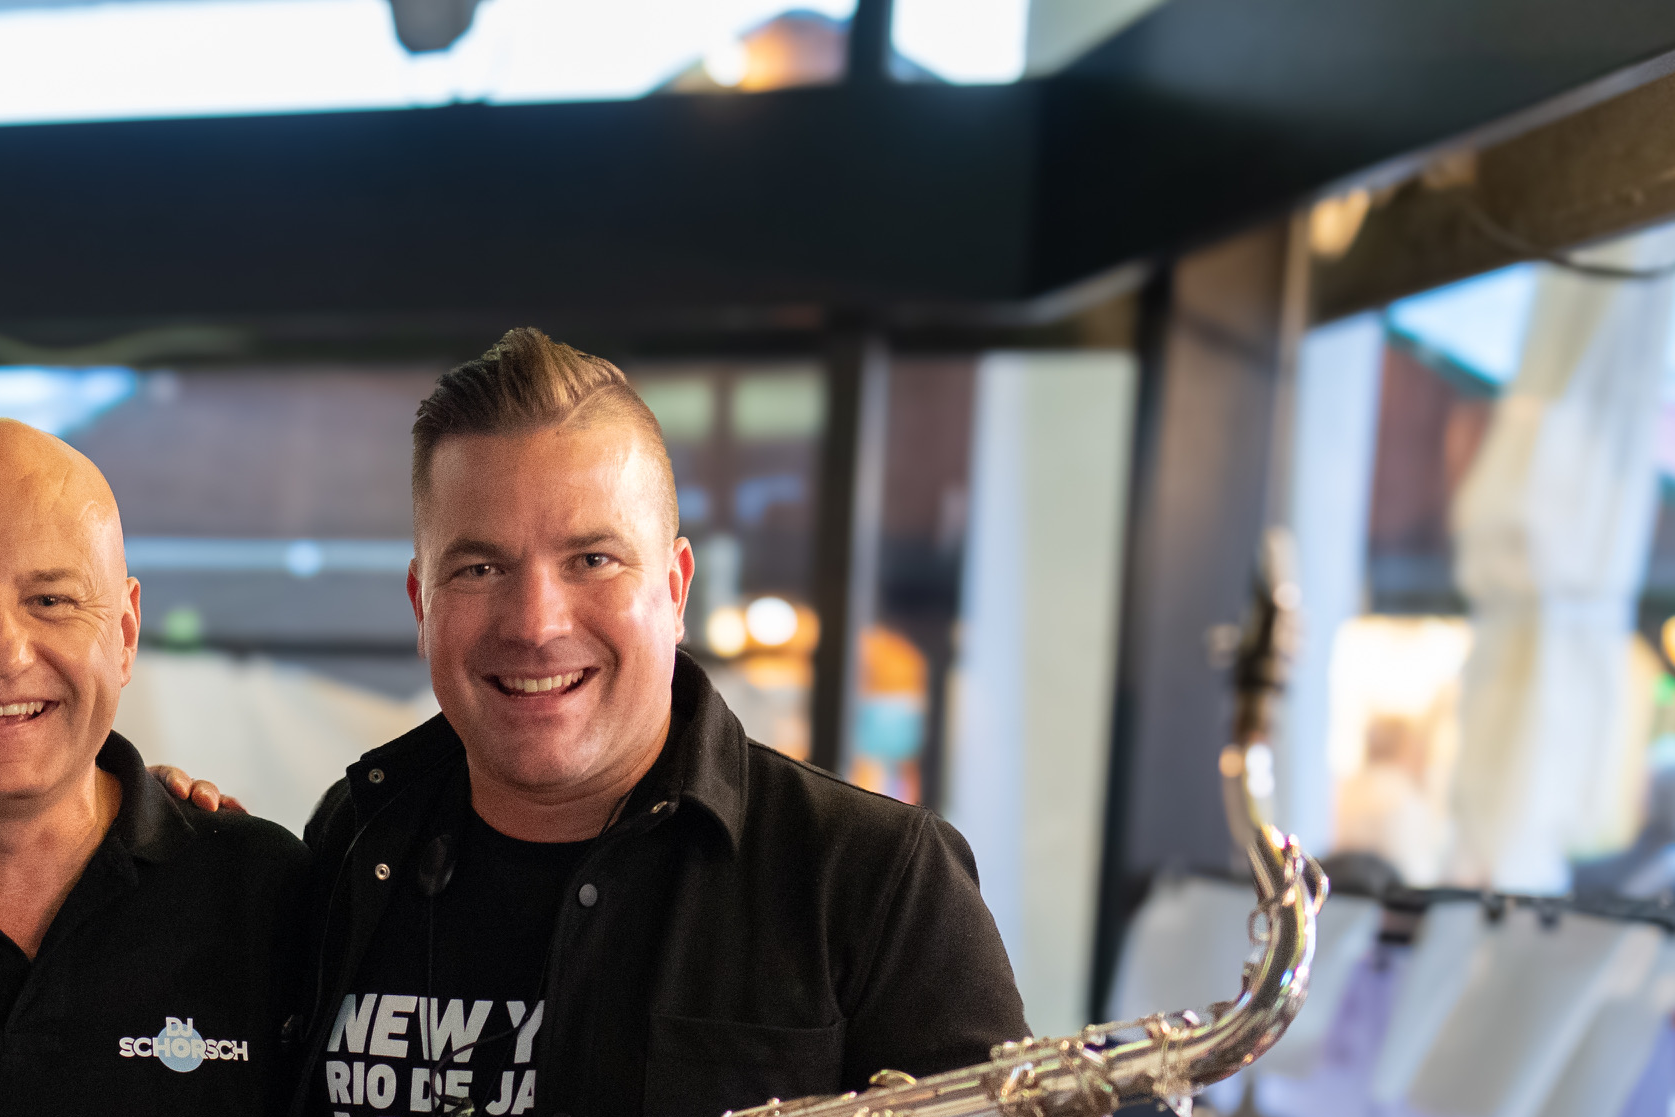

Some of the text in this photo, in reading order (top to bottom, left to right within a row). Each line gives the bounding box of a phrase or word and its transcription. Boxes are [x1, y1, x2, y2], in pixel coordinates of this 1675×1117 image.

[165, 1016, 193, 1038] DJ
[327, 993, 494, 1063] NEW
[119, 1036, 249, 1062] SCHORSCH
[326, 1060, 397, 1110] RIO
